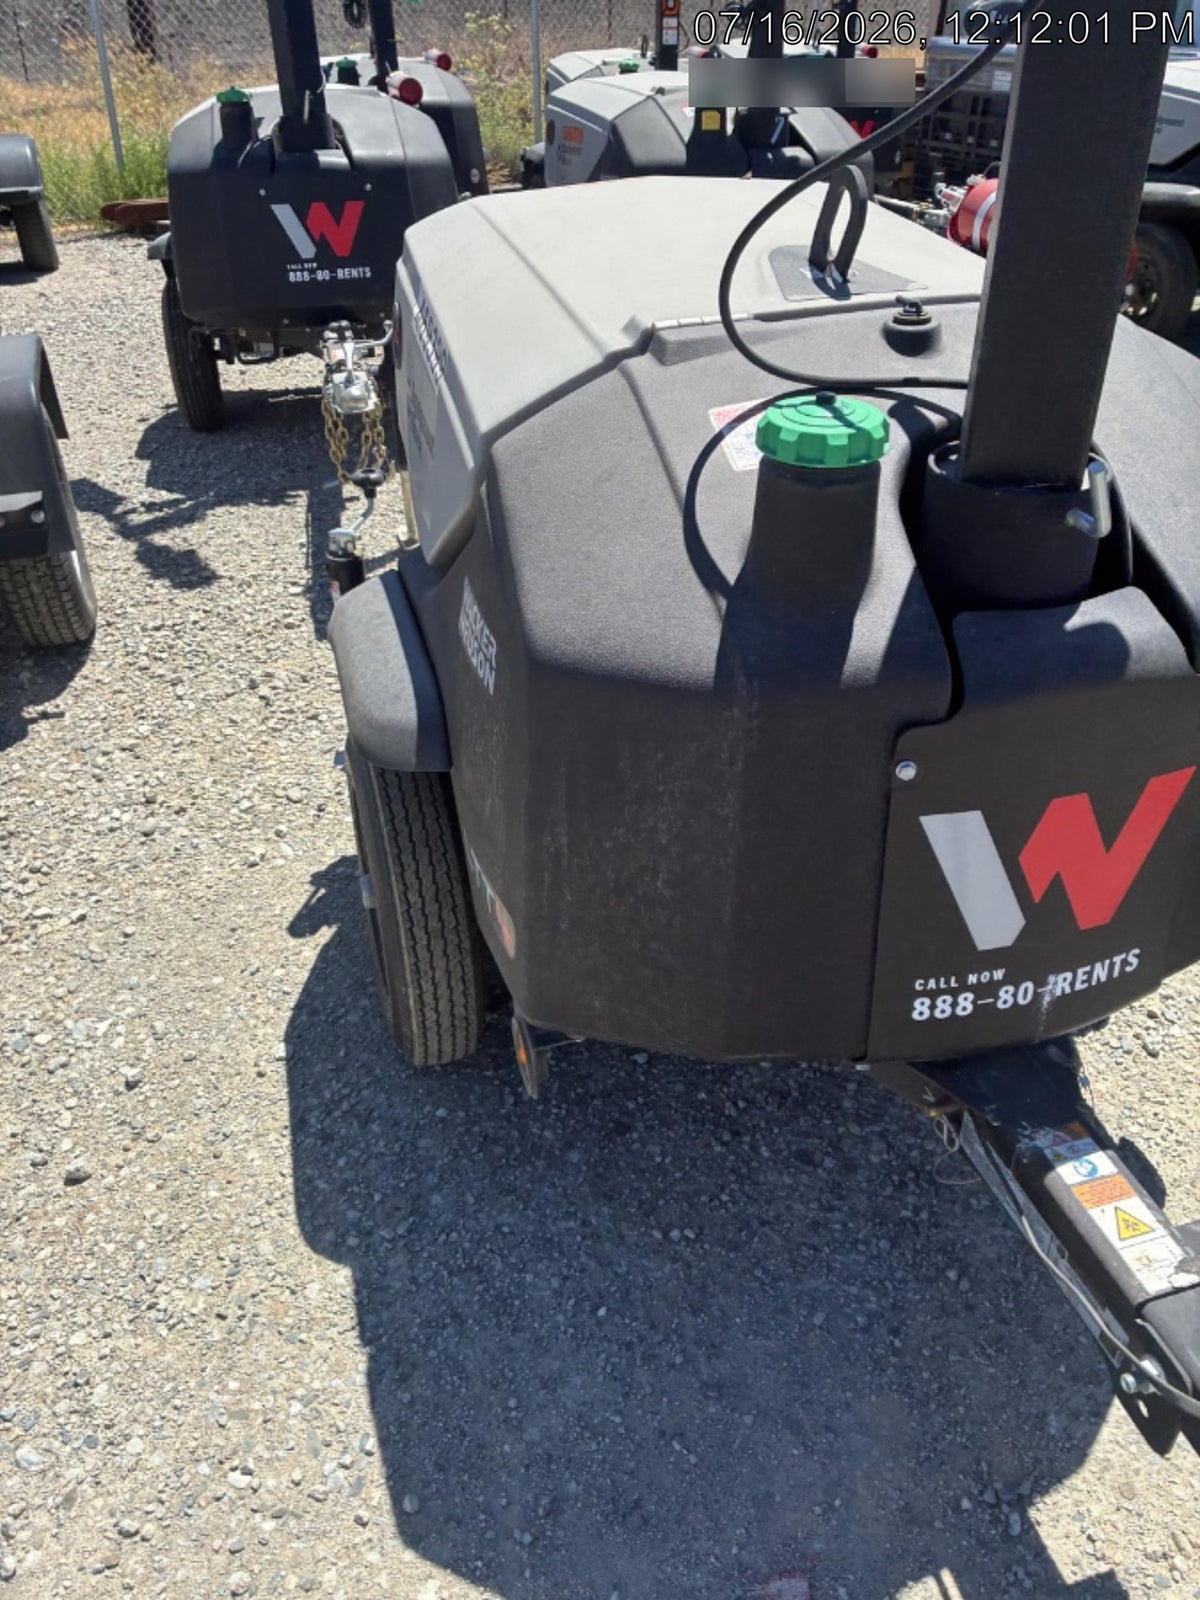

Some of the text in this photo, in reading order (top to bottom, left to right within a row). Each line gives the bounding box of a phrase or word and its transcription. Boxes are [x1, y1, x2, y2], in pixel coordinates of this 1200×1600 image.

[289, 267, 372, 282] 888-80-RENTS
[911, 948, 1141, 1022] 888-80-RENTS
[914, 968, 1006, 991] CALL NOW
